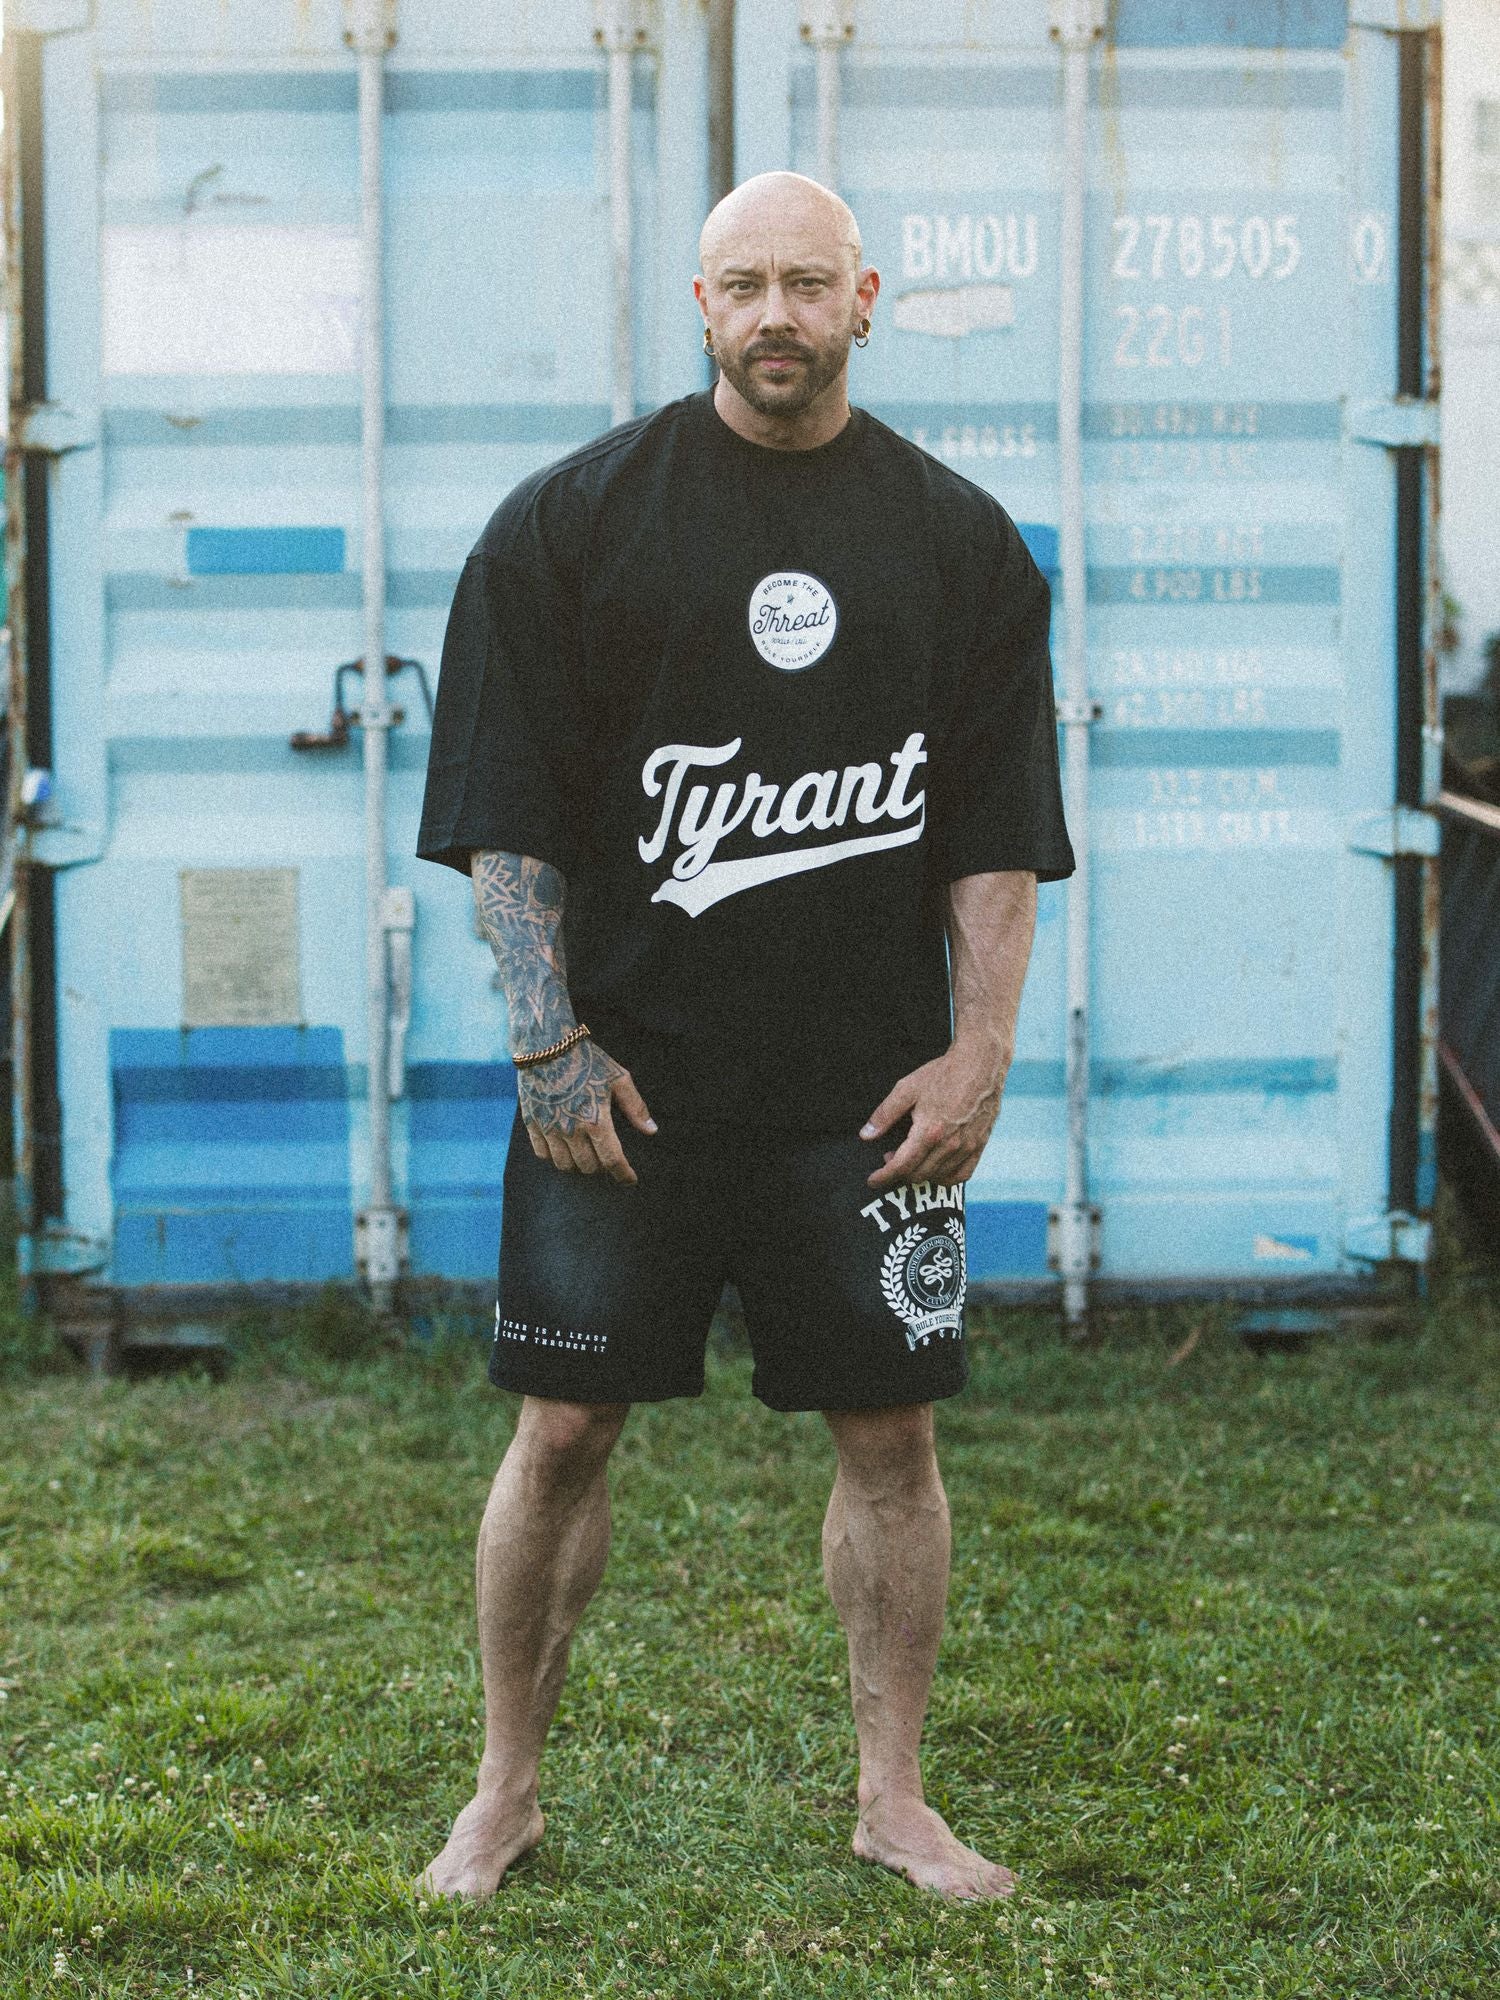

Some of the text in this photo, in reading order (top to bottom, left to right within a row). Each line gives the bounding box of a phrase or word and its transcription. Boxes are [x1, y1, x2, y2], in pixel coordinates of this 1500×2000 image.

[902, 214, 1040, 279] BMOU
[1112, 214, 1302, 279] 278505
[762, 579, 820, 597] BECOME THE
[752, 598, 830, 635] Threat
[638, 732, 928, 881] Tyrant
[860, 1180, 964, 1233] TYRAN
[503, 1320, 528, 1331] FEAR
[535, 1326, 547, 1335] IS
[569, 1331, 608, 1342] LEASH
[534, 1337, 587, 1351] THROUGH
[593, 1345, 606, 1353] IT
